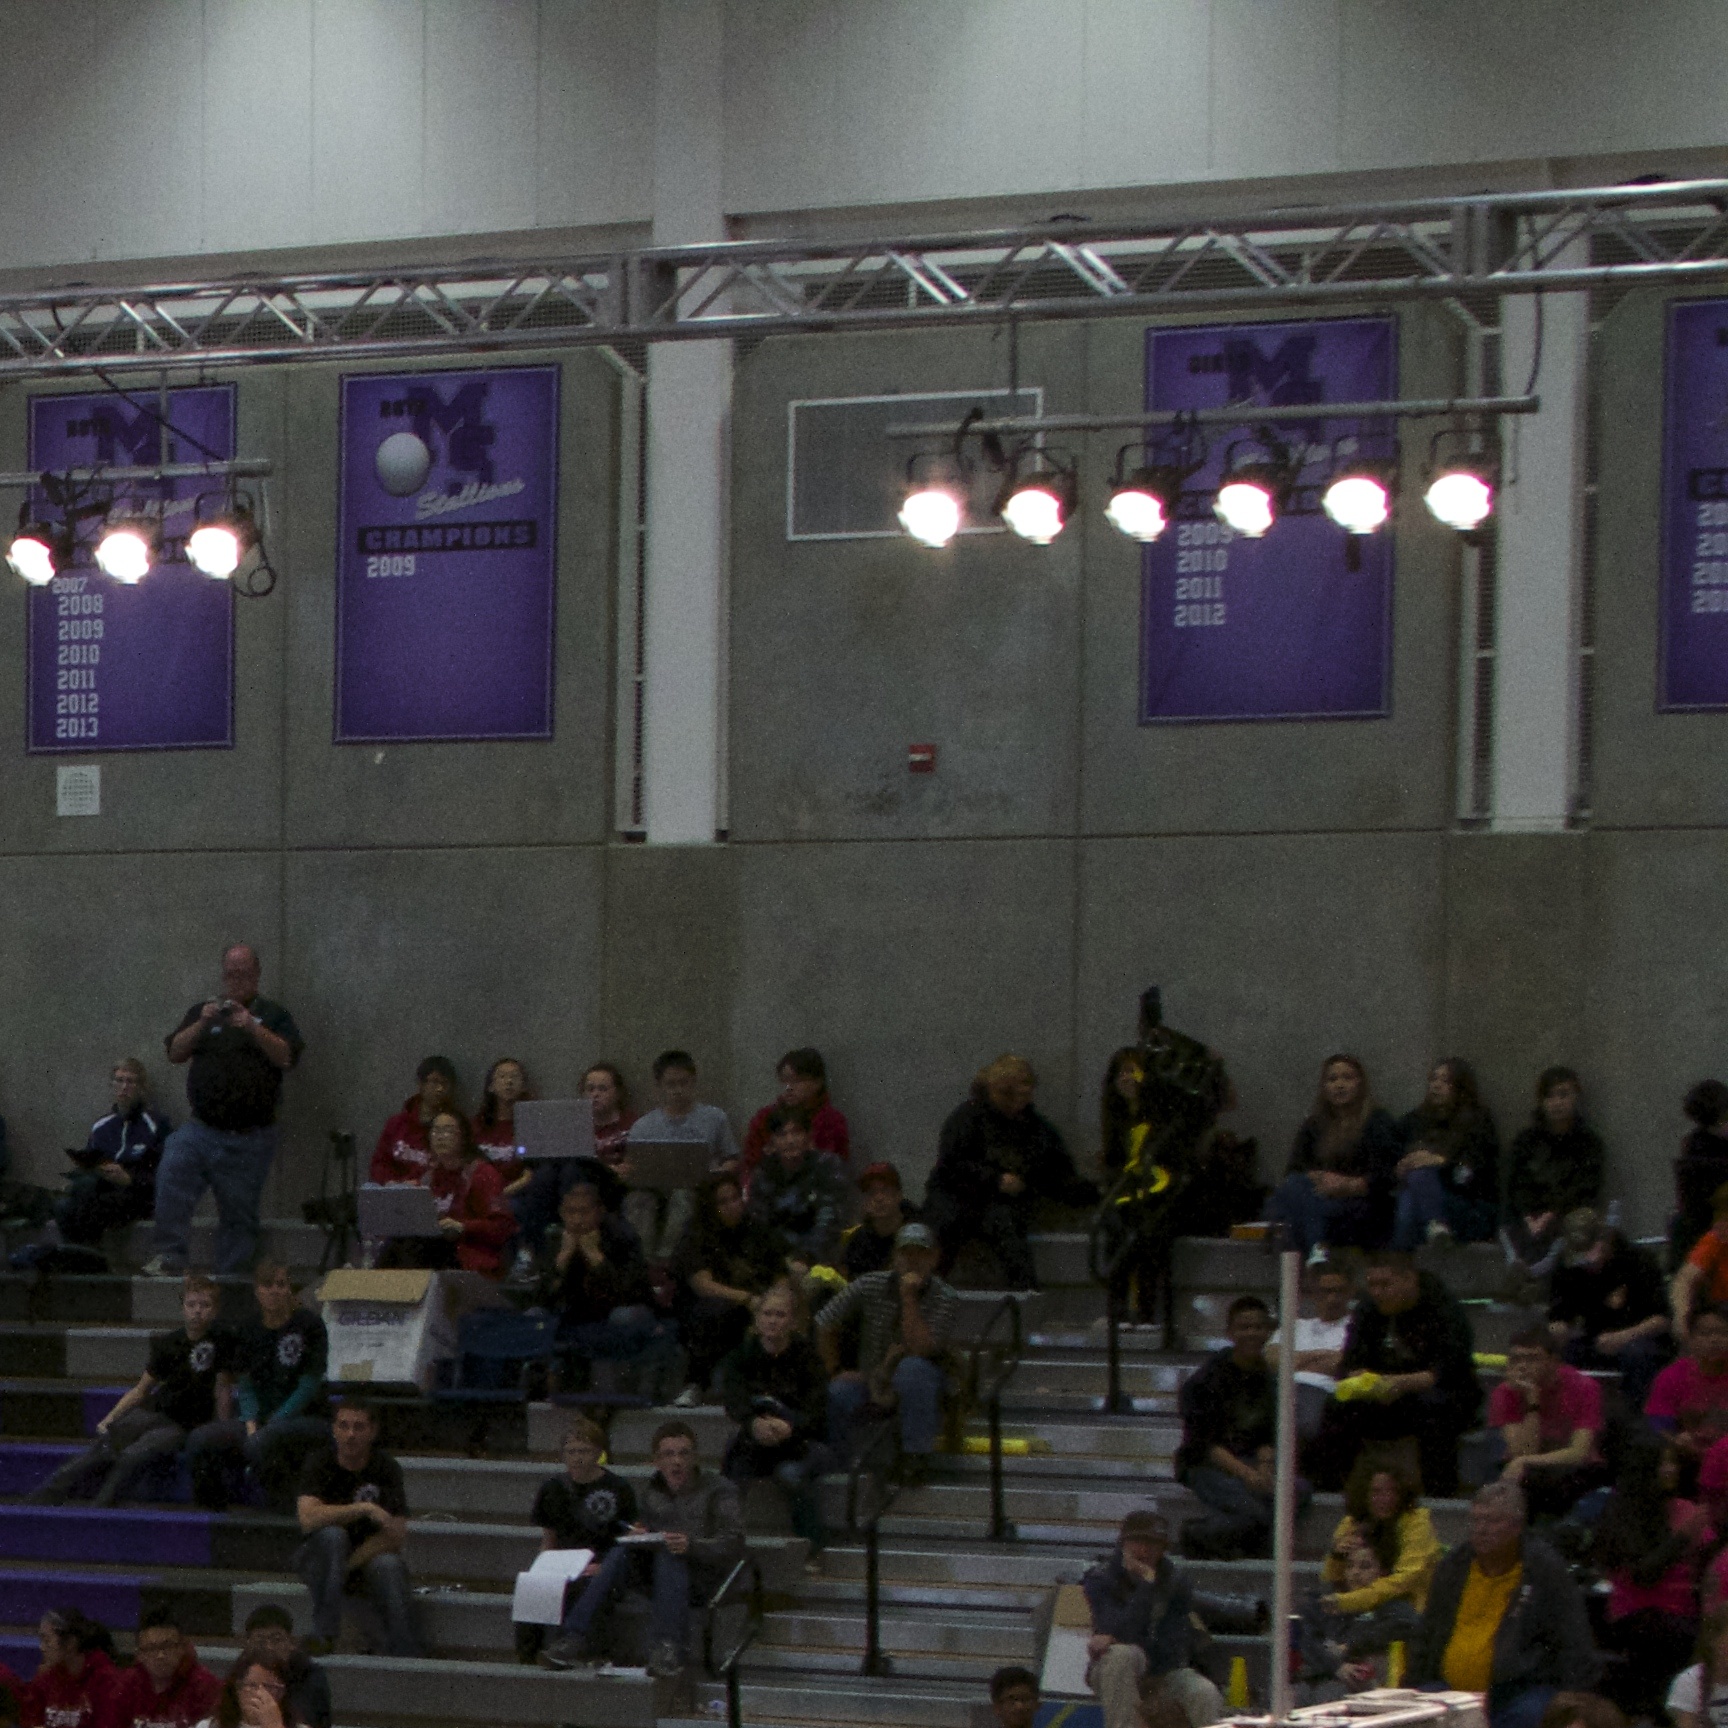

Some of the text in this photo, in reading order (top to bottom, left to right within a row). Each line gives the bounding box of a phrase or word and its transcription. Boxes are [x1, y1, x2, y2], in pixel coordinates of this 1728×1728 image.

[364, 526, 530, 550] CHAMPIONS
[366, 555, 415, 578] 2009
[55, 717, 99, 738] 2013
